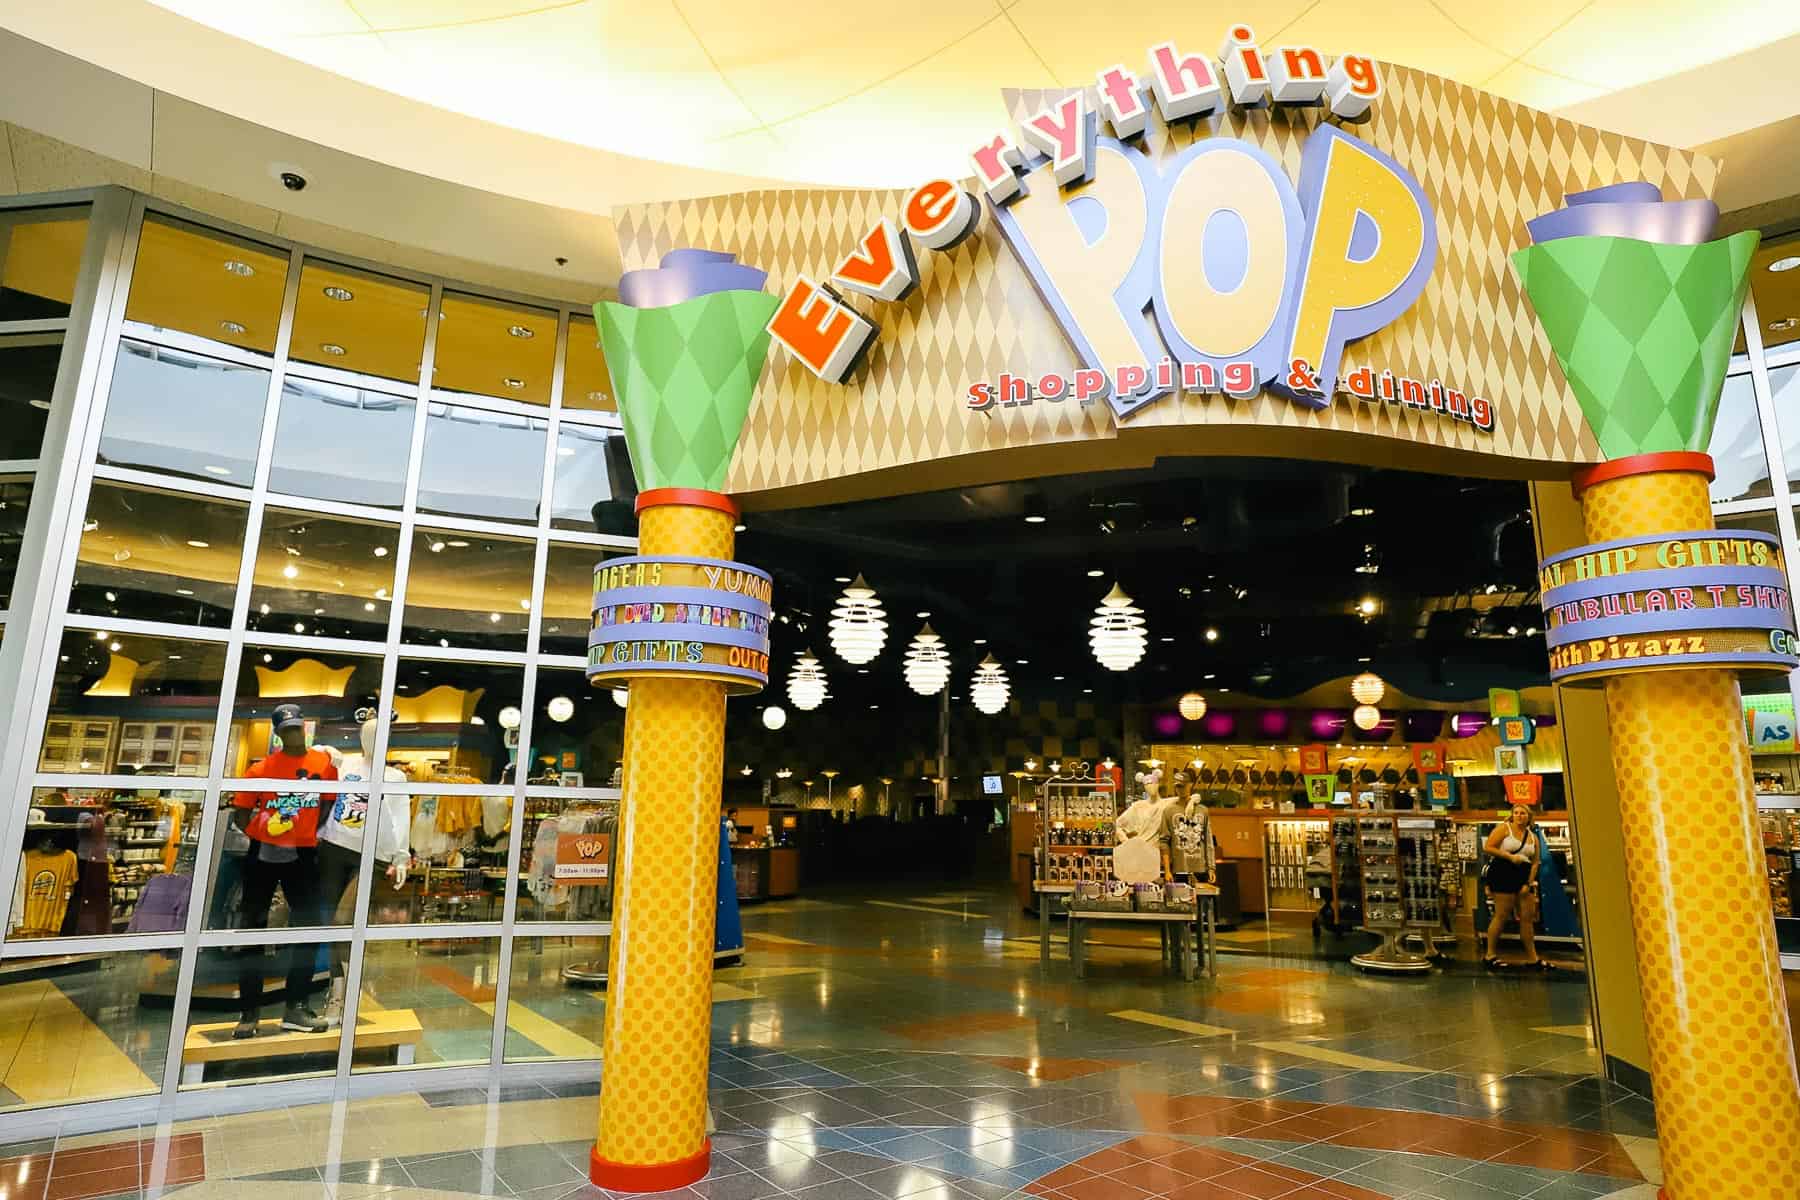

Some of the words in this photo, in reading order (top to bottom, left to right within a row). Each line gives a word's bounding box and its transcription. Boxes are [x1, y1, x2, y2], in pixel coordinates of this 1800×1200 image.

[766, 24, 1381, 380] Everything
[990, 124, 1434, 408] POP
[967, 355, 1257, 408] shopping
[1287, 357, 1325, 392] &
[1347, 366, 1492, 429] dining
[1540, 563, 1566, 593] AL
[1574, 547, 1638, 582] HIP
[1656, 540, 1768, 569] GIFTS
[1555, 588, 1696, 625] TUBULAR
[1706, 584, 1726, 609] T
[612, 641, 704, 664] GIFTS
[1588, 636, 1706, 663] Pizazz
[575, 840, 603, 859] POP
